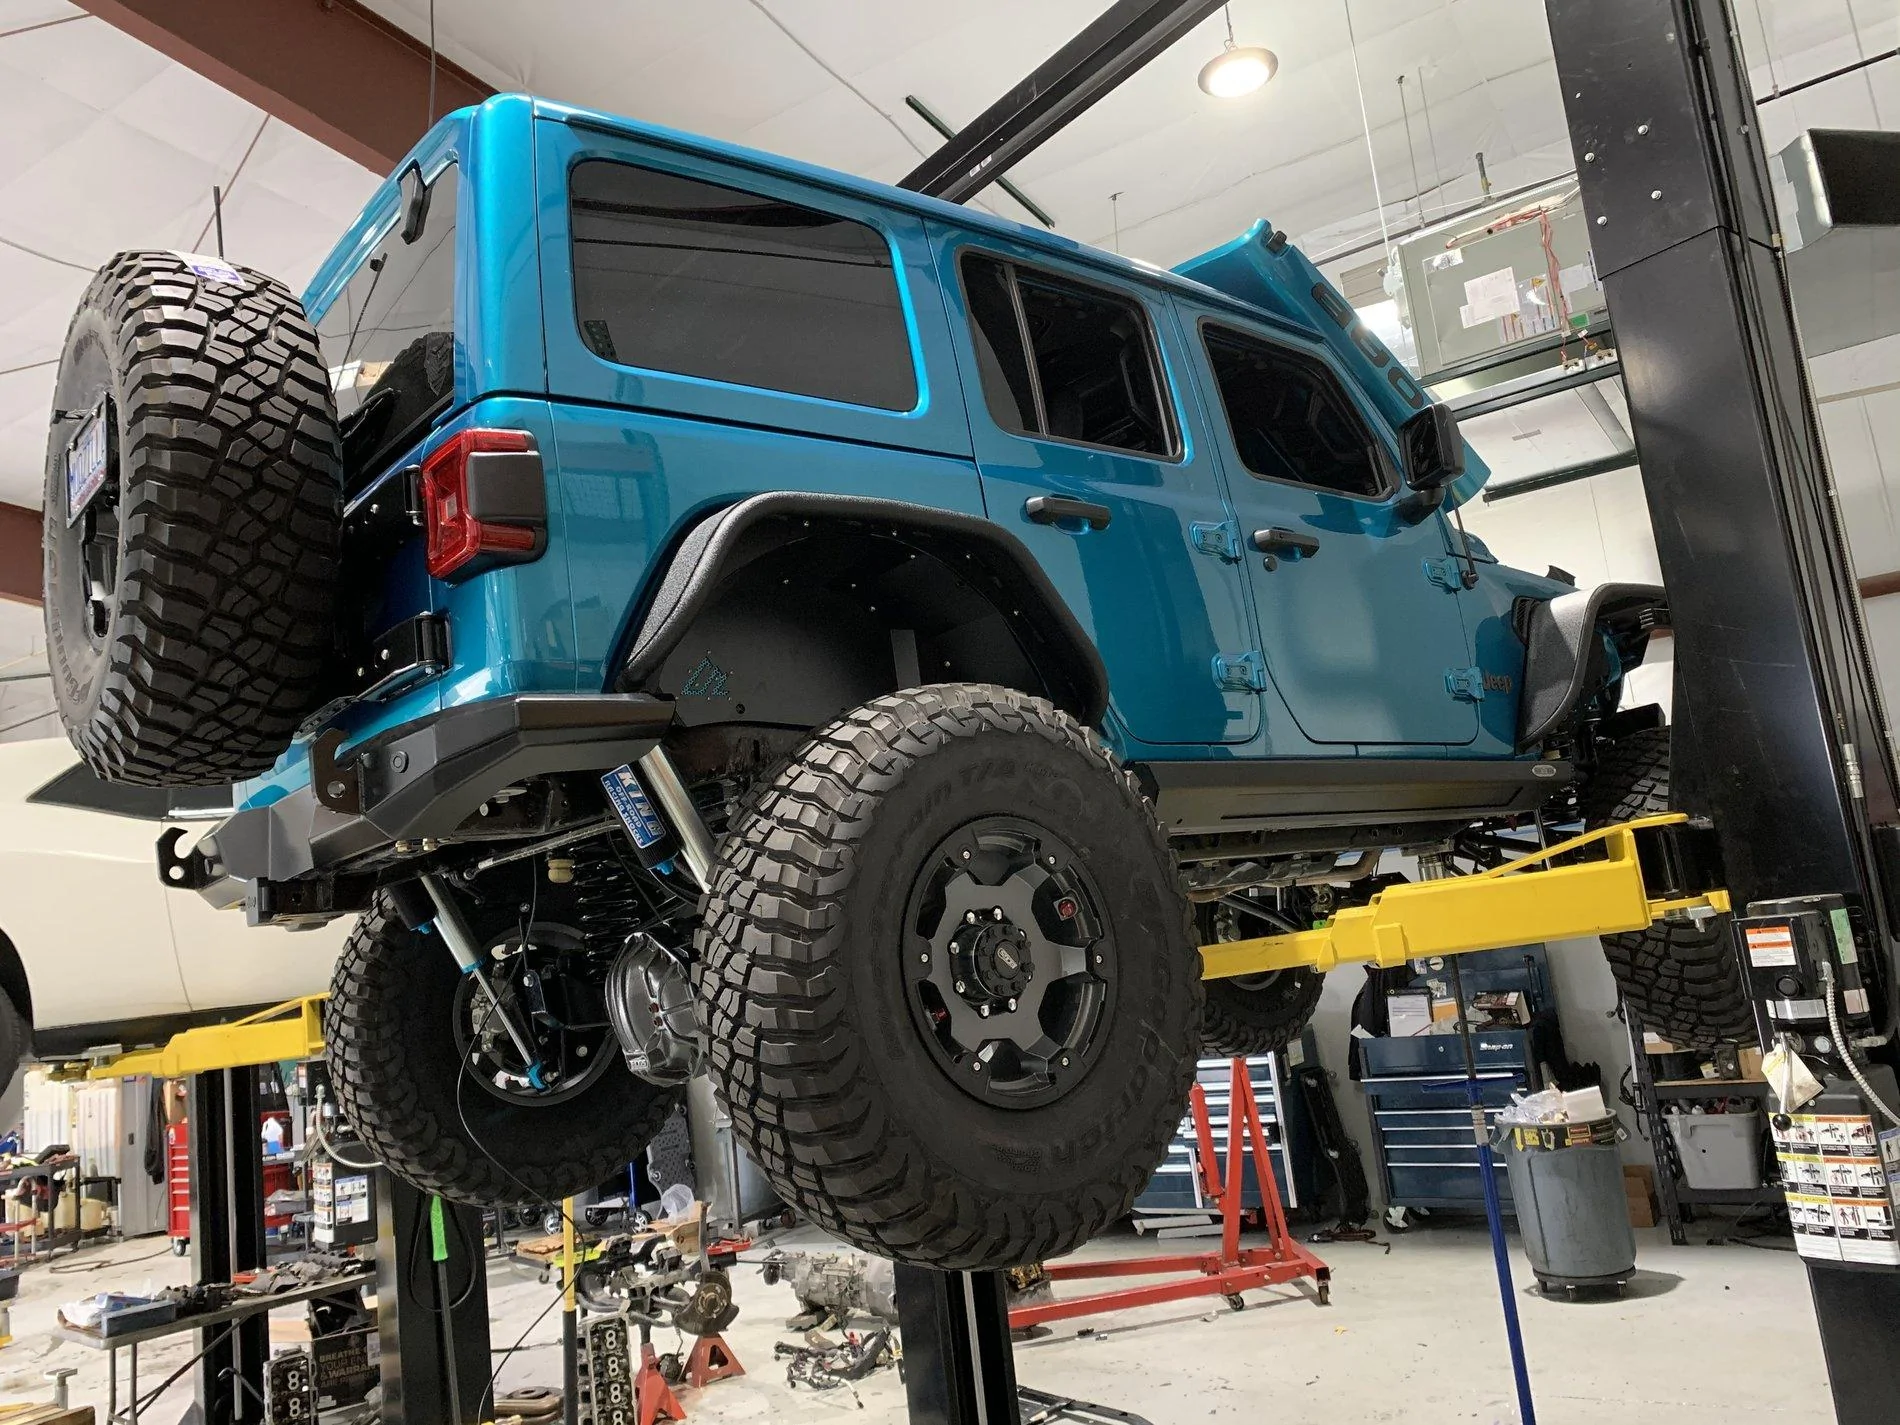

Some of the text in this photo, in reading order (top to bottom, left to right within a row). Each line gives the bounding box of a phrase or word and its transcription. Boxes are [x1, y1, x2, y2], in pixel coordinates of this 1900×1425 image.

[604, 780, 644, 845] RACING SHOCKS
[615, 786, 642, 828] OFF-ROAD
[618, 772, 662, 836] KING
[1479, 1042, 1514, 1052] Snap-on
[319, 1348, 361, 1362] BREATHE
